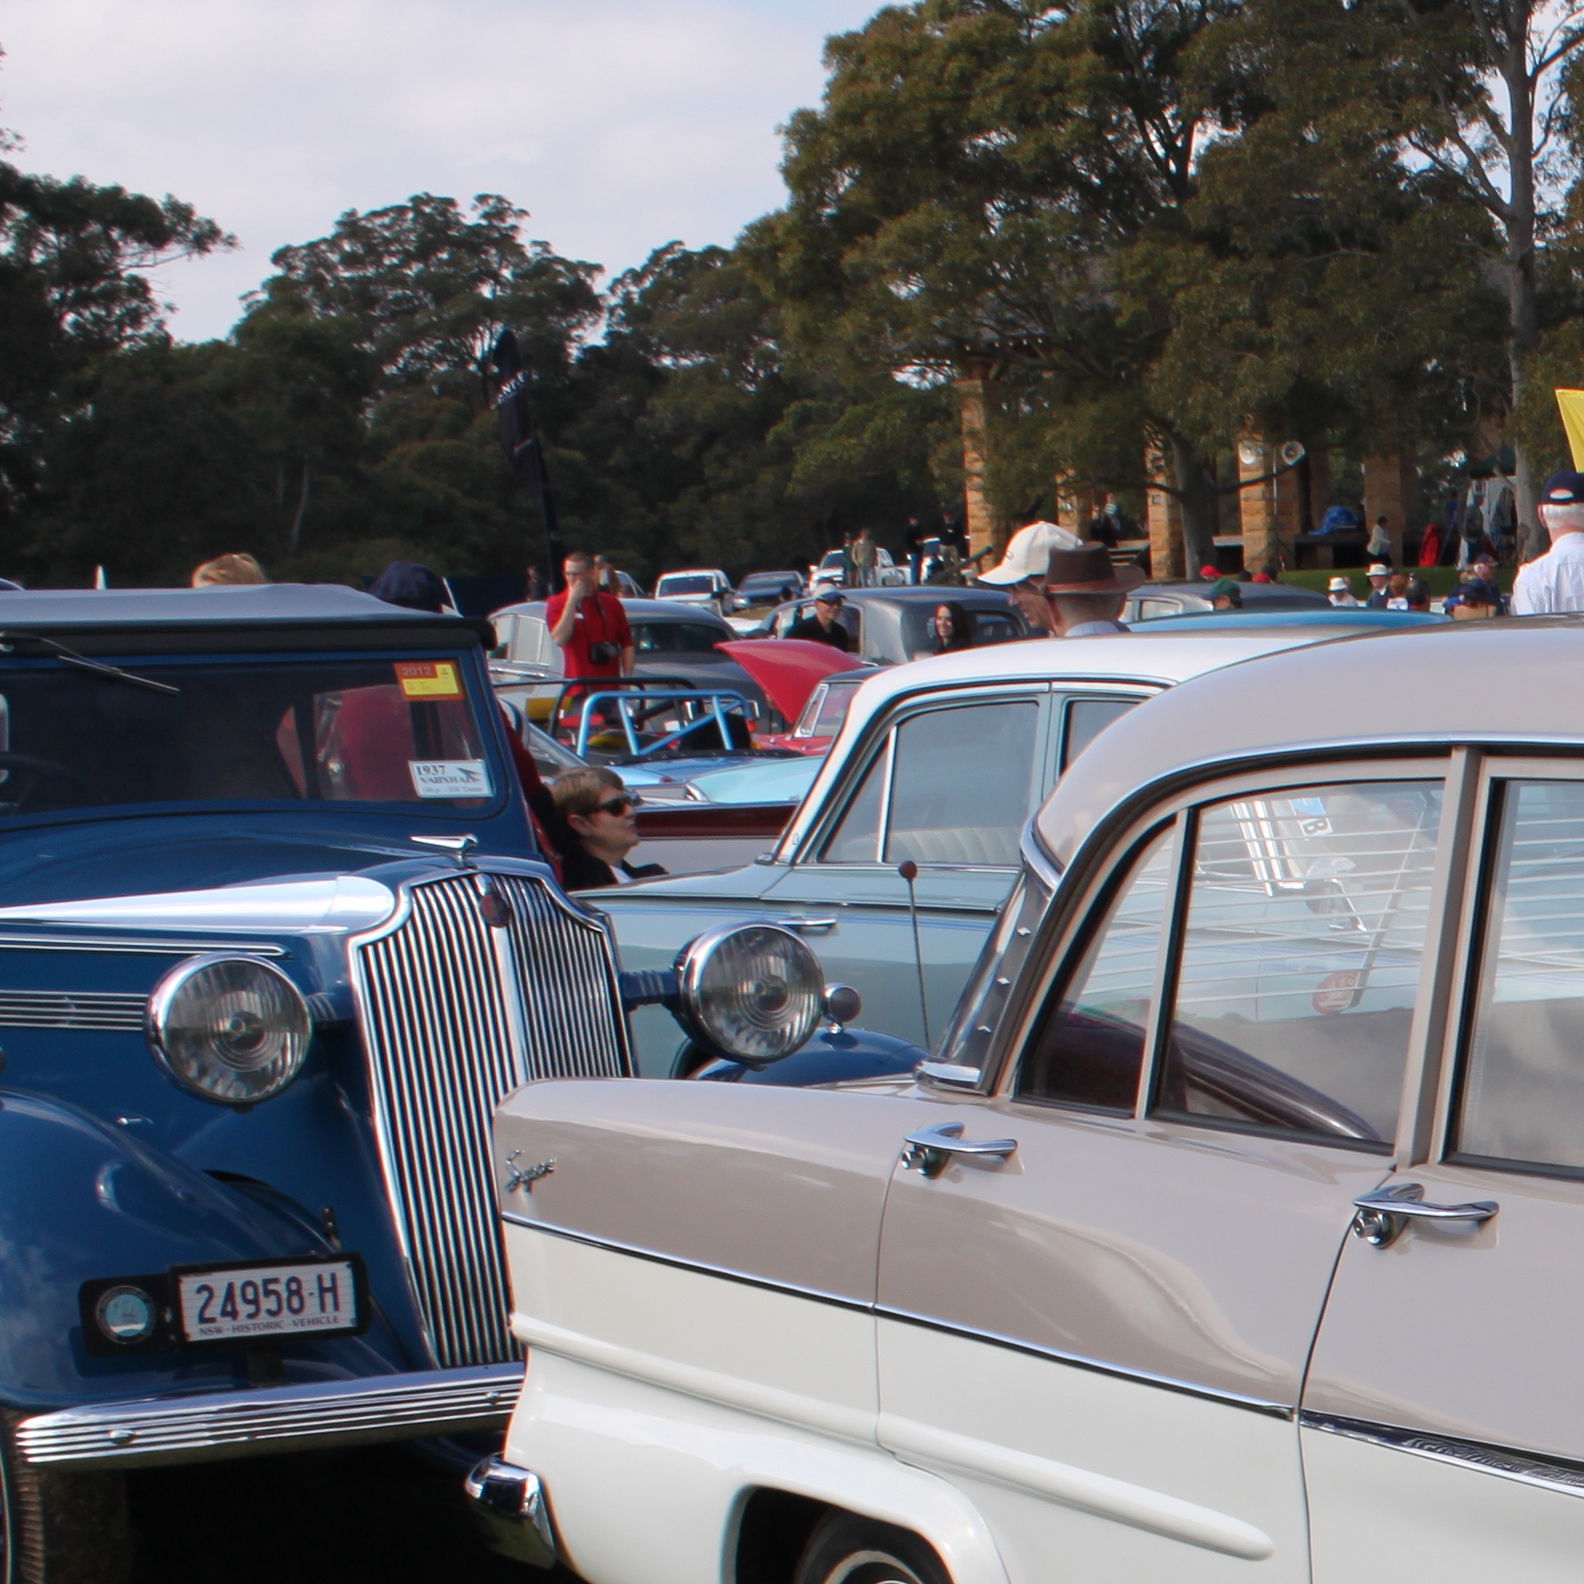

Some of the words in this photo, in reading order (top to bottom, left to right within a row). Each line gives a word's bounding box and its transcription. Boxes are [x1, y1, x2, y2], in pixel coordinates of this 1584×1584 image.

[402, 667, 432, 676] 2012
[416, 765, 447, 776] 1937
[292, 1314, 340, 1327] VEHICLE
